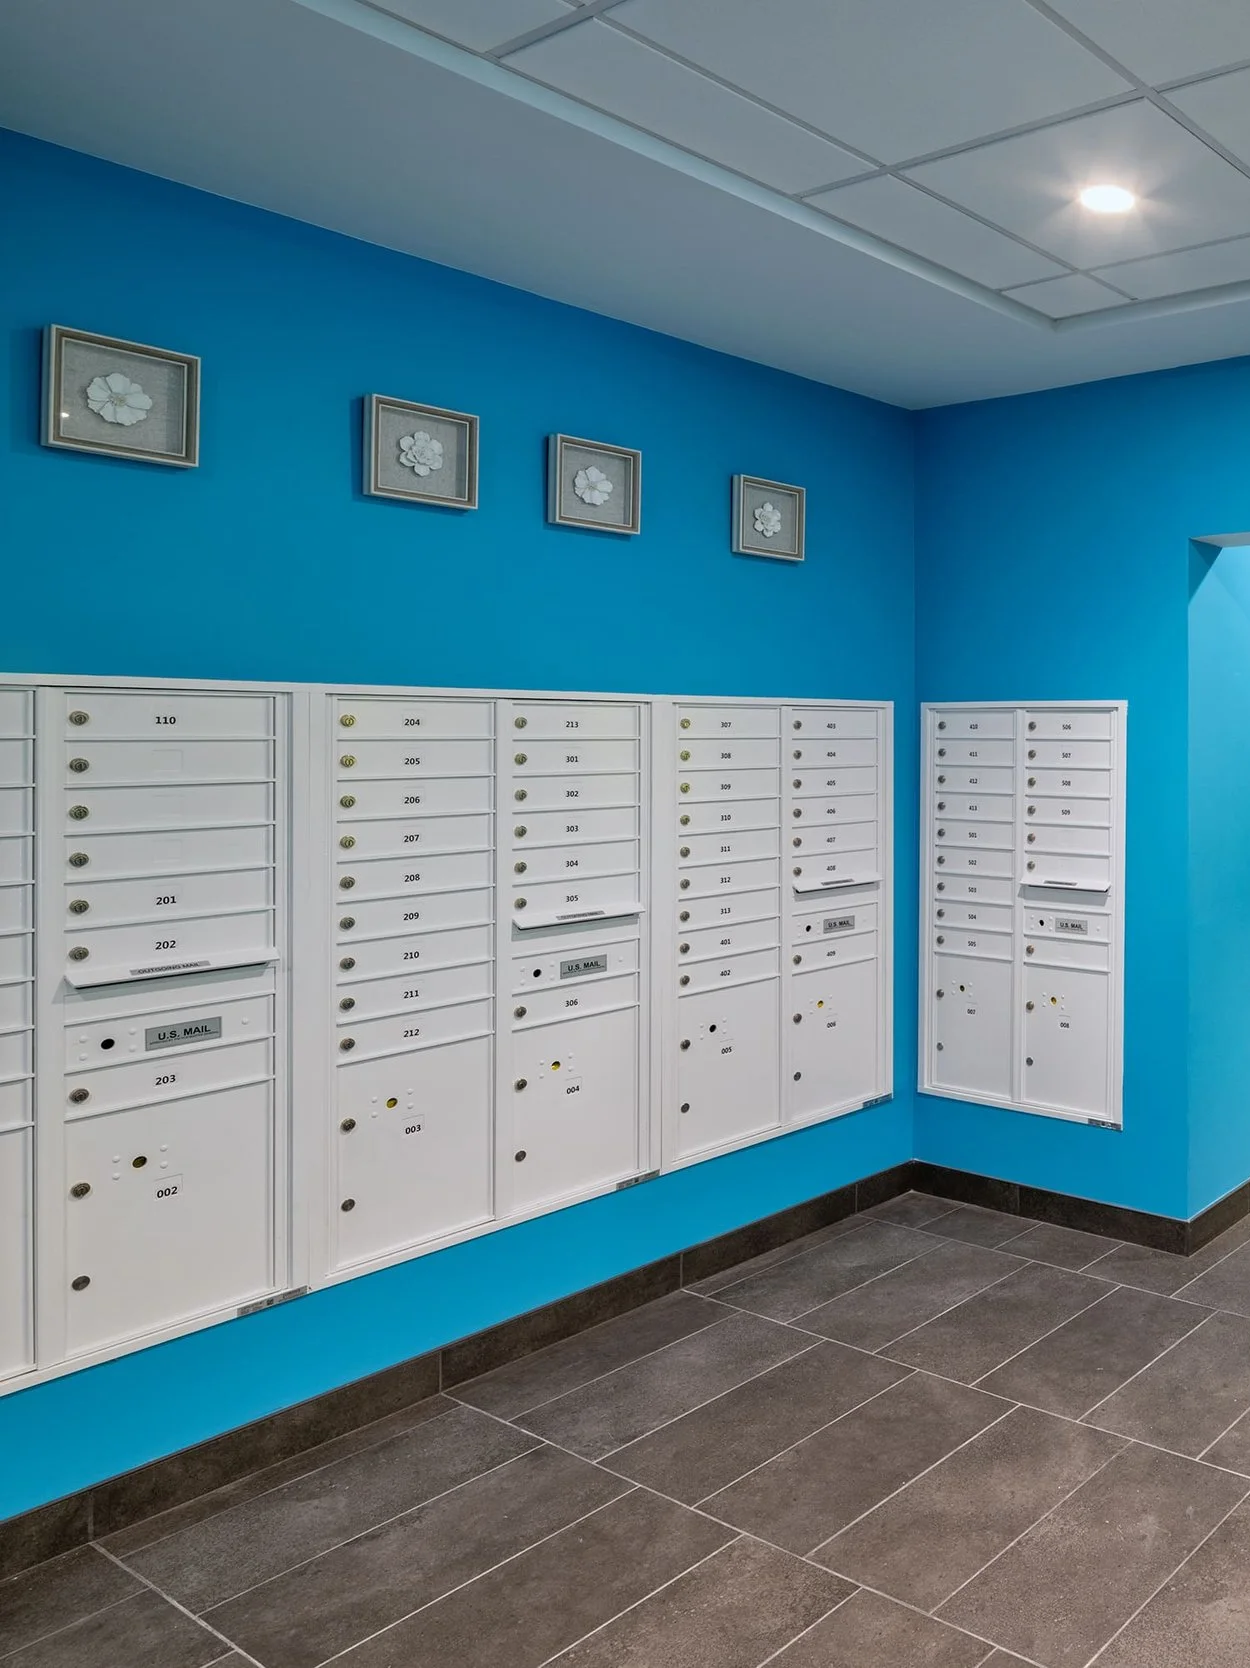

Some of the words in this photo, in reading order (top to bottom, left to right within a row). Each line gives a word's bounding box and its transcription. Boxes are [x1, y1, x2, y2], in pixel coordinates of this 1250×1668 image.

[155, 716, 177, 725] 110
[404, 718, 421, 727] 204
[565, 720, 579, 729] 213
[566, 755, 579, 763] 301
[720, 752, 732, 760] 308
[404, 757, 421, 766] 205
[720, 783, 732, 791] 309
[565, 790, 579, 798] 302
[404, 795, 421, 805] 206
[720, 814, 732, 822] 310
[565, 824, 579, 833] 303
[403, 834, 420, 843] 207
[720, 845, 731, 853] 311
[565, 859, 579, 868] 304
[404, 873, 421, 883] 208
[720, 876, 731, 884] 312
[155, 895, 177, 906] 201
[565, 894, 579, 903] 305
[720, 907, 731, 915] 313
[403, 911, 420, 921] 209
[155, 939, 177, 951] 202
[719, 938, 731, 946] 401
[403, 950, 420, 960] 210
[138, 964, 181, 974] OUTGOING
[567, 963, 582, 972] U.S.
[583, 960, 601, 969] MAIL
[719, 969, 731, 977] 402
[403, 989, 420, 999] 211
[565, 998, 579, 1008] 306
[158, 1030, 180, 1041] U.S.
[183, 1025, 211, 1037] MAIL
[403, 1028, 420, 1038] 212
[720, 1046, 733, 1055] 005
[155, 1074, 176, 1086] 203
[566, 1085, 580, 1095] 004
[405, 1124, 422, 1135] 003
[156, 1185, 178, 1199] 002
